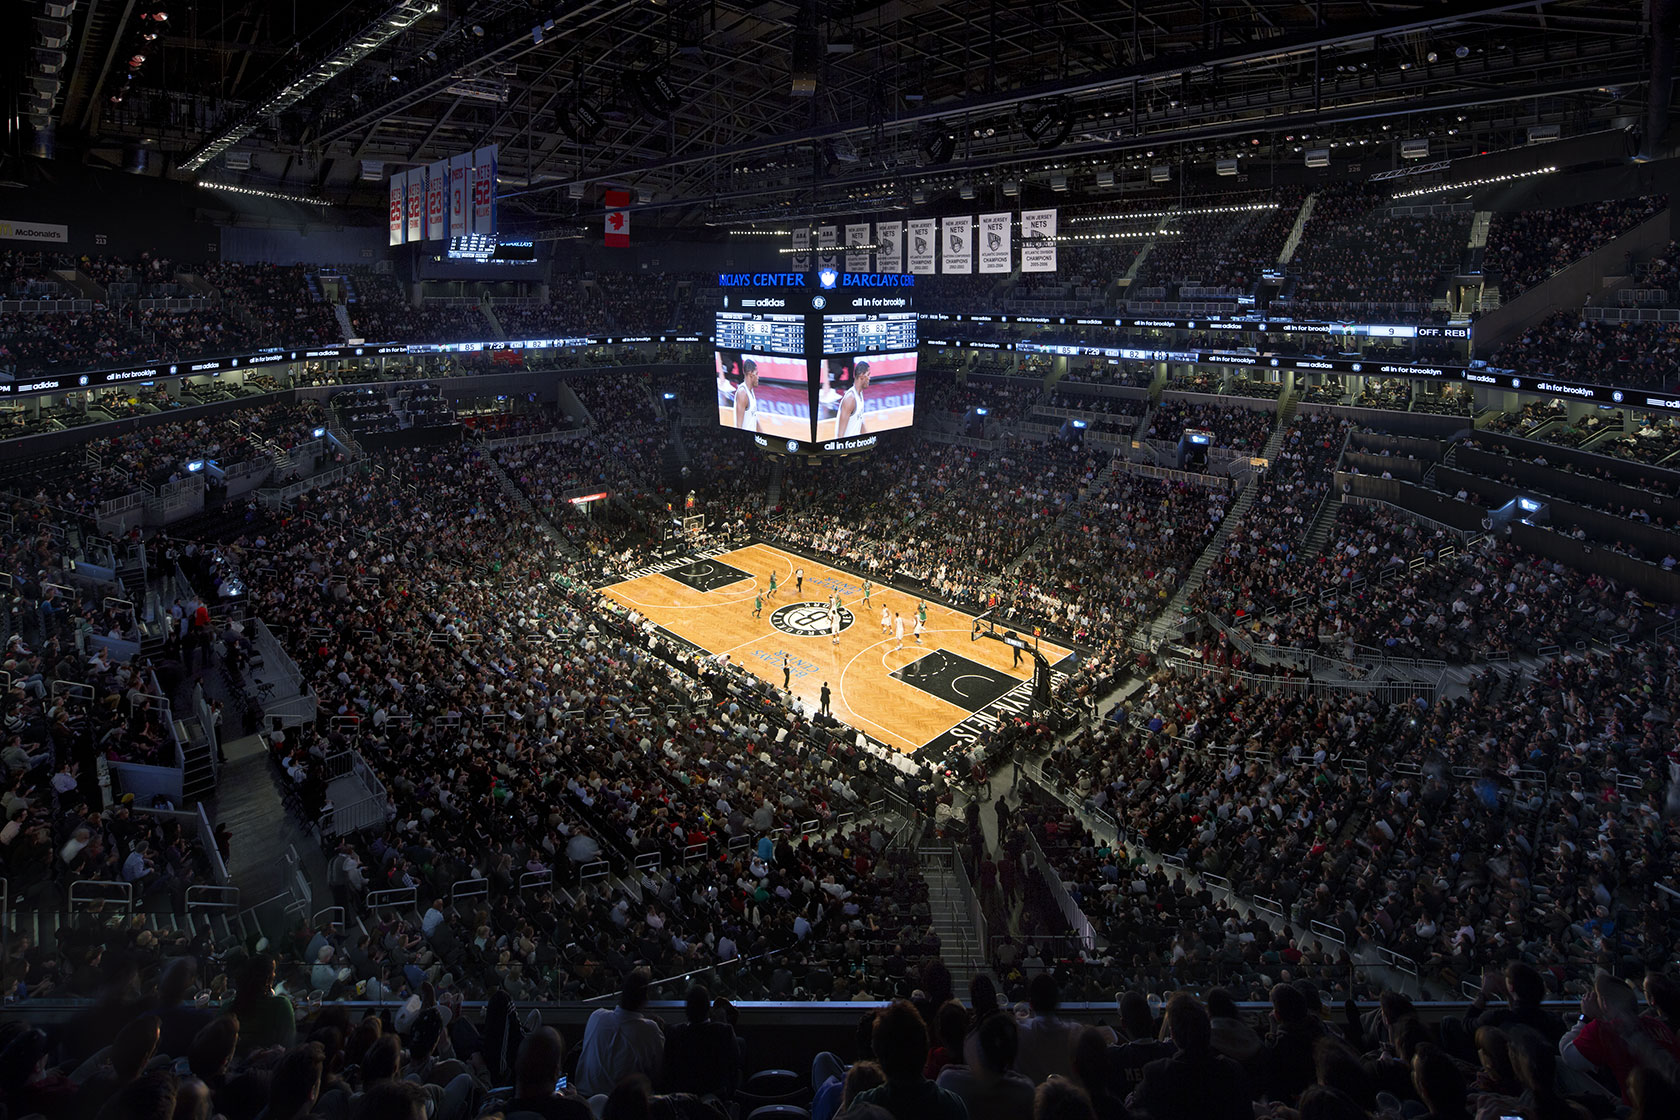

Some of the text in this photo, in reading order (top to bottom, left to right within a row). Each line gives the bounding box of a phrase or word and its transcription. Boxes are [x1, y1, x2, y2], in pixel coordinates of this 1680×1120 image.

[578, 107, 598, 125] SONY
[1032, 114, 1050, 132] SONY
[476, 164, 490, 179] NETS
[409, 184, 420, 195] NETS
[430, 178, 441, 190] NETS
[392, 188, 400, 200] NETS
[476, 180, 490, 206] 52
[408, 196, 420, 218] 32
[430, 192, 442, 214] 23
[454, 190, 461, 215] 3
[390, 201, 400, 222] 25
[15, 228, 60, 238] McDonald's
[754, 274, 805, 286] CENTER
[842, 274, 898, 286] BARCLAYS
[756, 298, 785, 306] adidas
[852, 298, 862, 306] all
[864, 298, 870, 306] in
[872, 298, 882, 306] for
[747, 324, 768, 333] 85 82
[861, 324, 884, 333] 85 82
[131, 369, 156, 378] brooklyn
[1410, 368, 1442, 376] brooklyn
[33, 381, 58, 390] adidas
[1476, 376, 1496, 384] adidas
[1563, 386, 1594, 397] brooklyn
[824, 440, 856, 450] all in for
[620, 547, 731, 580] BROOKLYN NETS
[774, 612, 827, 635] BROOKLYN
[752, 650, 808, 678] BACLAYS
[1124, 1068, 1144, 1082] NE
